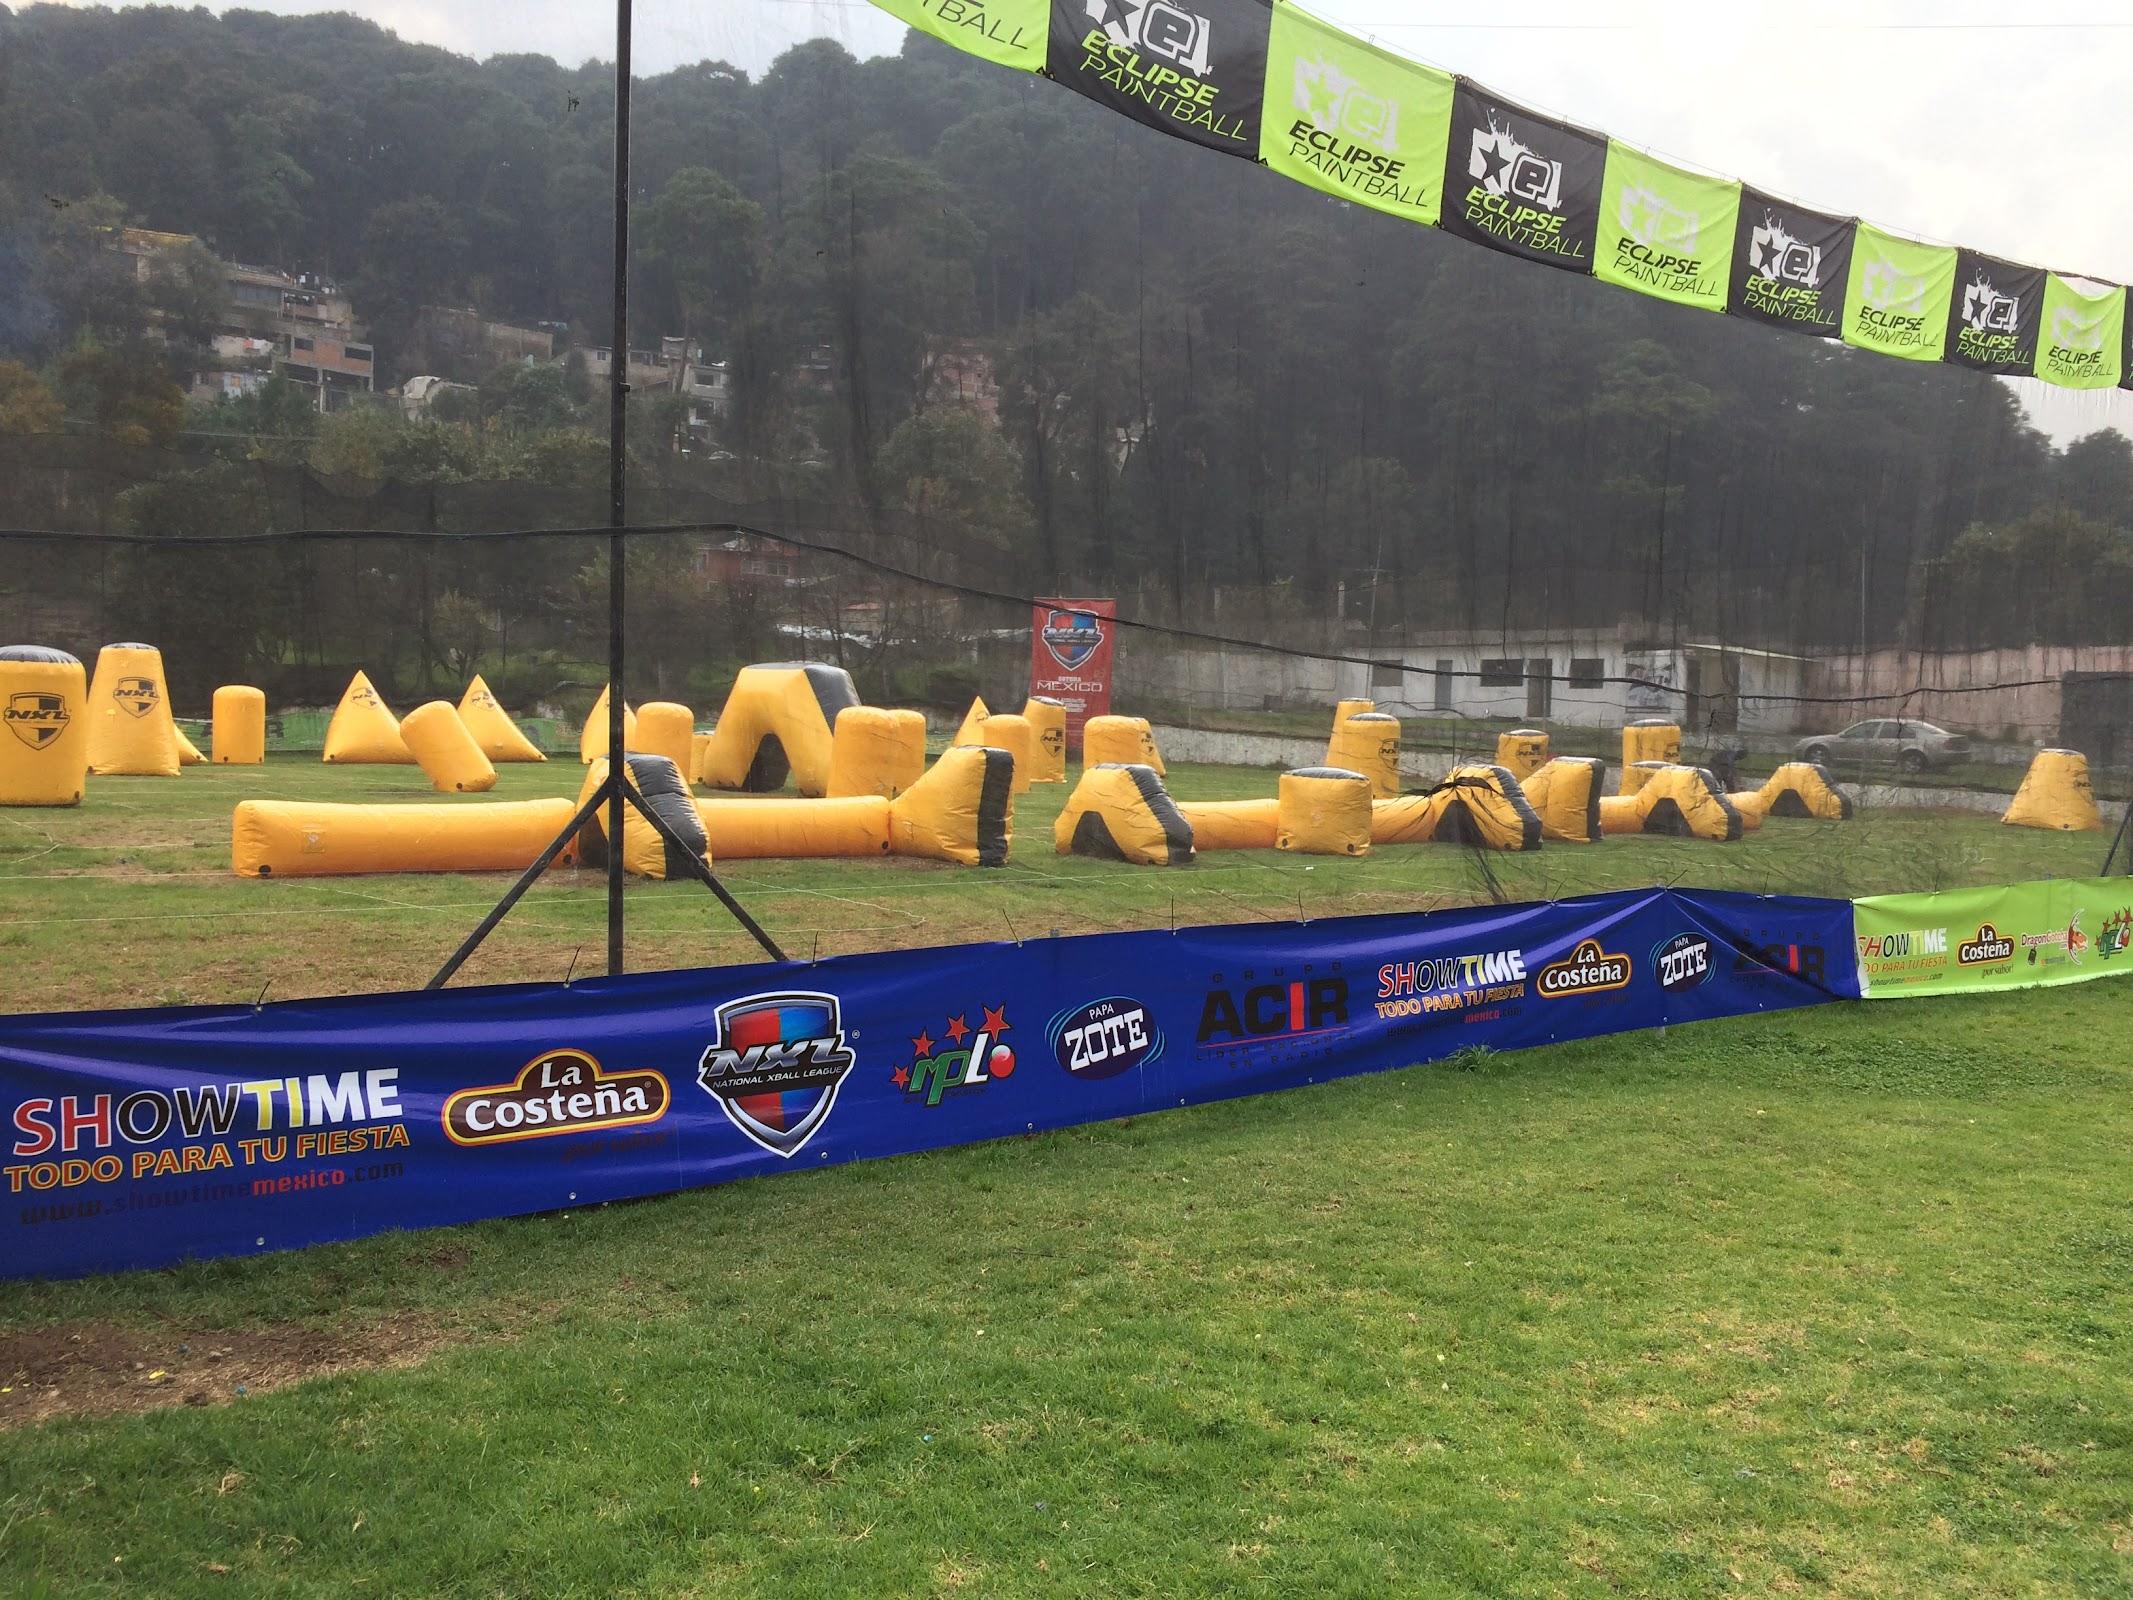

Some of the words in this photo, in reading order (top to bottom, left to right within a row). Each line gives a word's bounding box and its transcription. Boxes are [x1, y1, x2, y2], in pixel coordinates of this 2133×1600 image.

[1081, 29, 1220, 107] ECLIPSE
[1079, 54, 1248, 141] PAINTBALL
[1289, 119, 1406, 180] ECLIPSE
[1289, 142, 1429, 208] PAINTBALL
[1465, 185, 1567, 234] ECLIPSE
[1465, 206, 1586, 258] PAINTBALL
[1617, 237, 1702, 276] ECLIPSE
[1613, 255, 1719, 297] PAINTBALL
[1745, 273, 1822, 306] ECLIPSE
[1743, 291, 1838, 325] PAINTBALL
[1859, 305, 1926, 331] ECLIPSE
[1856, 320, 1939, 347] PAINTBALL
[1959, 326, 2019, 350] ECLIPSE
[1956, 341, 2030, 364] PAINTBALL
[2048, 345, 2103, 365] ECLIPSE
[115, 688, 159, 699] NXL
[1037, 681, 1103, 692] MEXICO
[6, 708, 69, 721] NXL
[1675, 937, 1690, 949] PAPA
[1857, 927, 1948, 959] SHOWTIME
[1961, 940, 2010, 961] Costeña
[1981, 927, 1994, 942] La
[1577, 947, 1596, 964] La
[1660, 942, 1708, 987] ZOTE
[1882, 960, 1905, 972] PARA
[1907, 958, 1919, 970] TU
[1920, 956, 1948, 968] FIESTA
[1378, 949, 1527, 998] SHOWTIME
[1545, 962, 1623, 990] Costeña
[1089, 1003, 1115, 1020] PAPA
[1196, 976, 1349, 1042] ACIR
[1375, 998, 1421, 1019] TODO
[1422, 993, 1463, 1013] PARA
[1464, 990, 1485, 1006] TU
[1483, 982, 1525, 1004] FIESTA
[1064, 1008, 1149, 1071] ZOTE
[707, 1037, 851, 1077] NXL
[540, 1062, 583, 1089] La
[712, 1076, 764, 1089] NATIONAL
[766, 1070, 800, 1082] XBALL
[803, 1065, 843, 1078] LEAGUE
[13, 1067, 403, 1157] SHOWTIME
[465, 1082, 650, 1132] Costeña
[3, 1155, 123, 1193] TODO
[132, 1143, 234, 1178] PARA
[238, 1136, 288, 1165] TU
[297, 1123, 411, 1158] FIESTA
